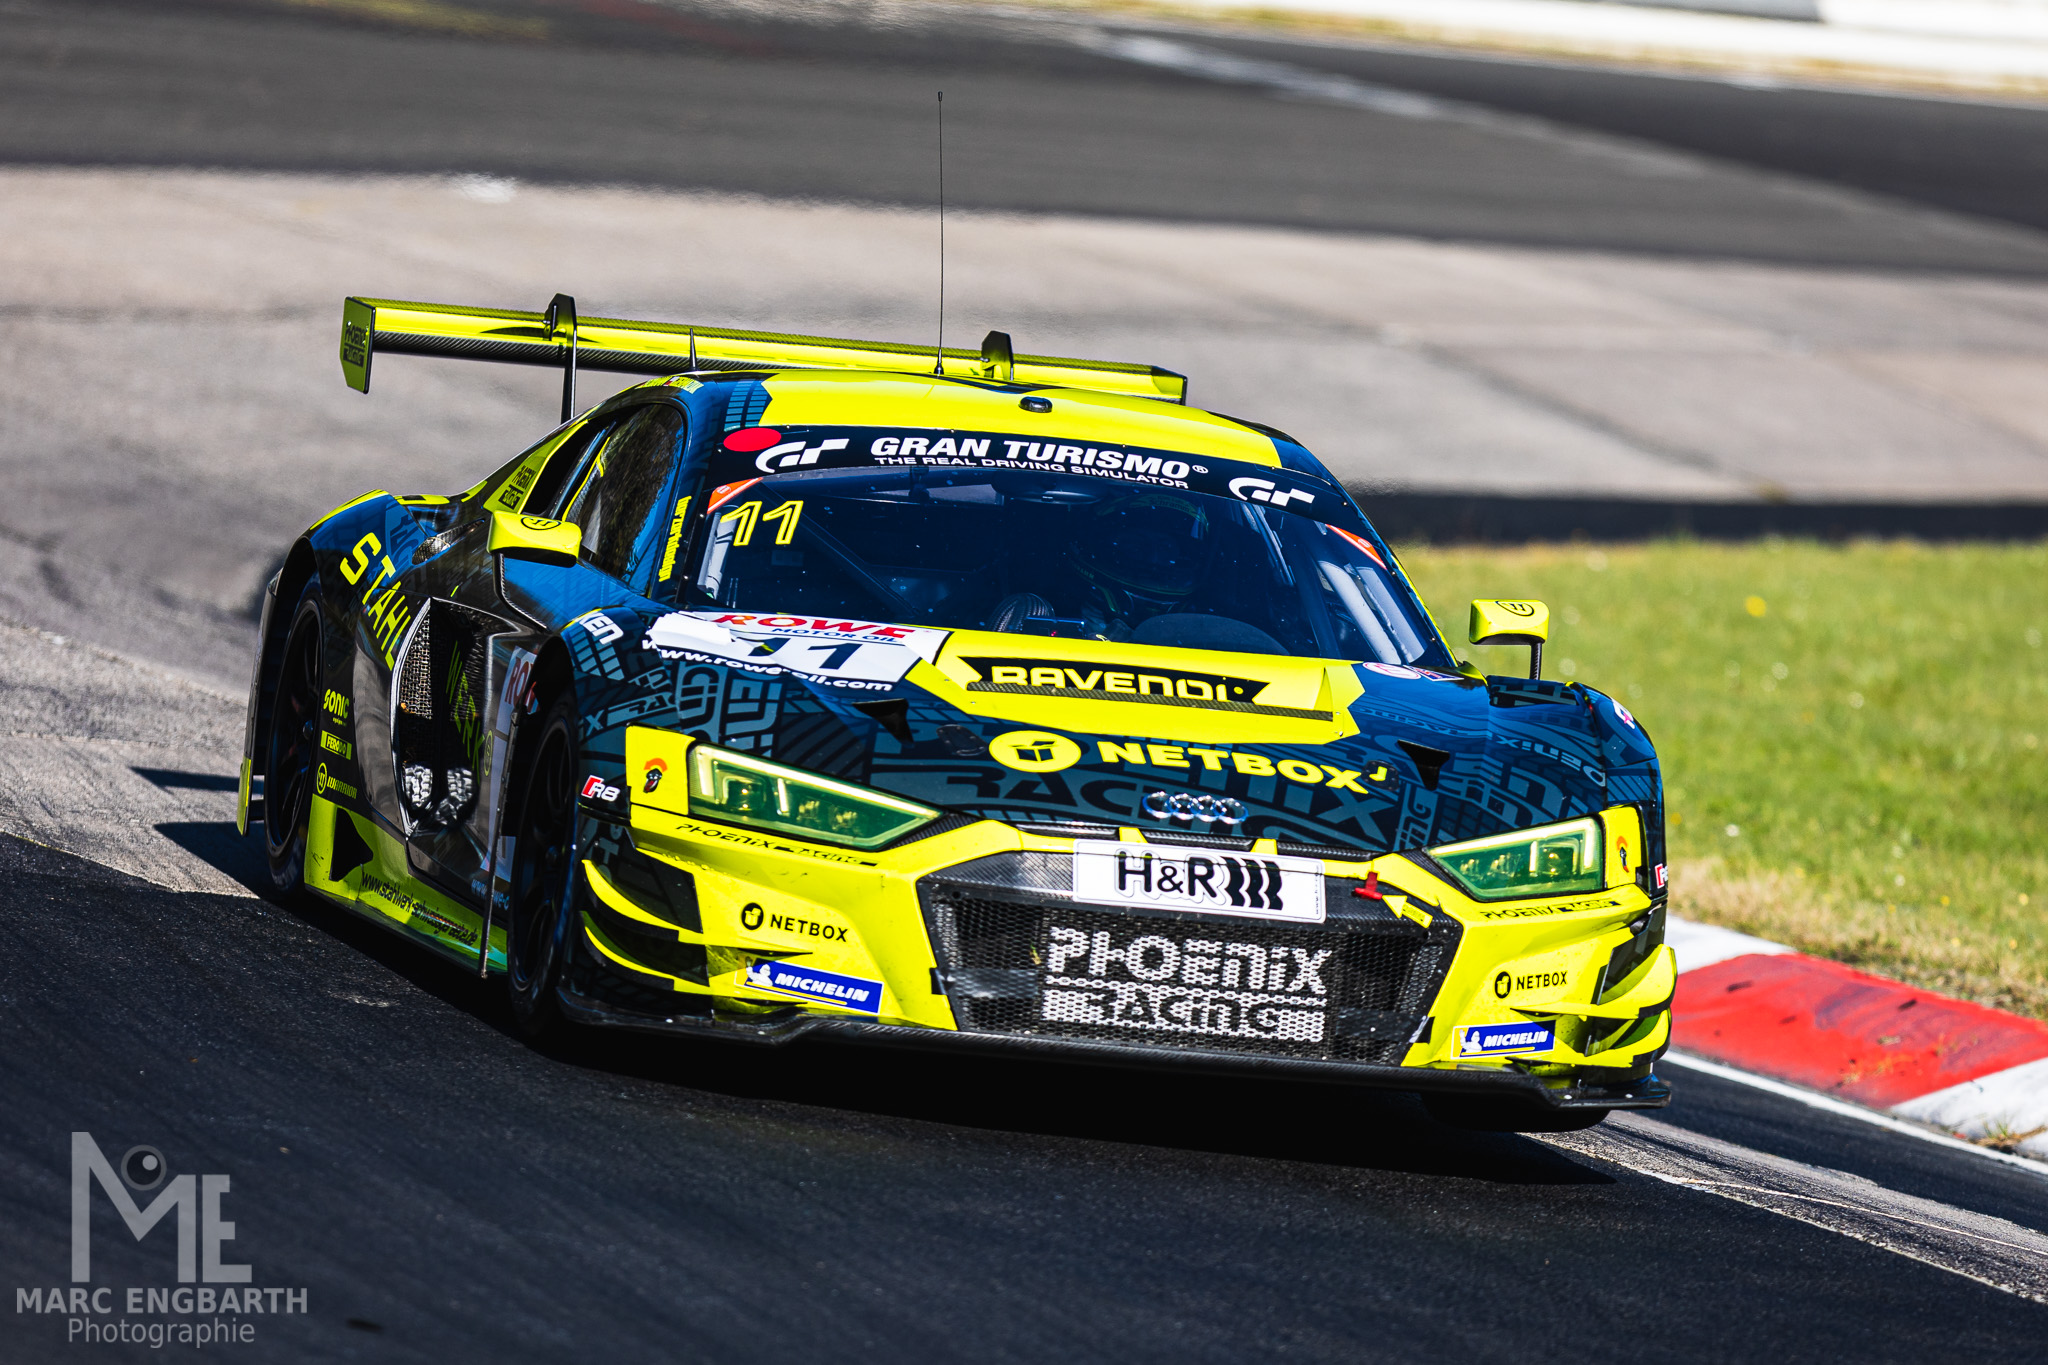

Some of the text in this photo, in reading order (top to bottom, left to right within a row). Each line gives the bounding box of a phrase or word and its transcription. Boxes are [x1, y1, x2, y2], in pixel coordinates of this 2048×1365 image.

[870, 437, 991, 457] GRAN
[874, 457, 1189, 489] THE REAL DRIVING SIMULATOR
[720, 501, 803, 546] 11
[717, 614, 916, 638] ROWE
[772, 628, 898, 642] MOTOR OIL
[1097, 740, 1368, 794] NETBOX
[585, 776, 621, 802] R8
[1117, 851, 1217, 898] H&R
[769, 914, 848, 943] NETBOX
[774, 972, 870, 1003] MICHELIN
[1516, 970, 1568, 991] NETBOX
[1483, 1028, 1549, 1047] MICHELIN
